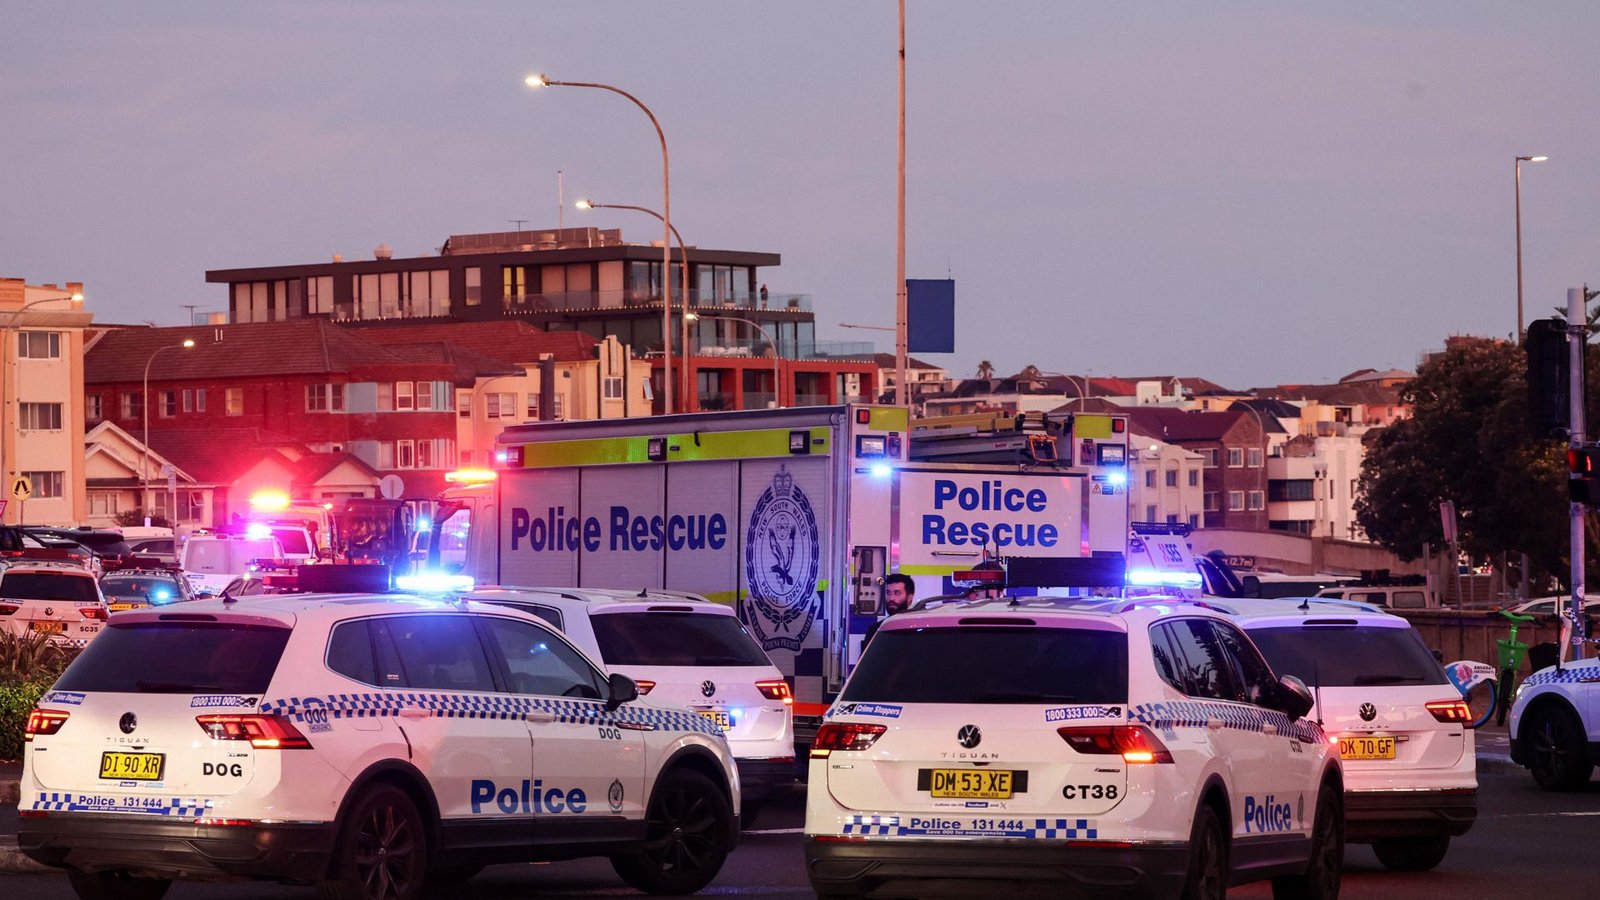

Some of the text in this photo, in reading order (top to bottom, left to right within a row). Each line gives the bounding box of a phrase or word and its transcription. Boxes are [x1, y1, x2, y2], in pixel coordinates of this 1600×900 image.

[934, 480, 1047, 512] Police
[770, 501, 789, 515] SOUTH
[511, 506, 727, 552] Police Rescue
[922, 515, 1058, 548] Rescue
[762, 581, 779, 604] POLICE
[208, 697, 221, 706] 333
[223, 696, 236, 706] 000
[305, 708, 327, 724] 000
[857, 704, 900, 716] Crime Stoppers
[1046, 707, 1098, 720] 1800 333 000
[599, 727, 622, 740] DOG
[1359, 740, 1374, 754] 70
[1378, 740, 1392, 754] GF
[124, 756, 139, 773] 90
[142, 757, 159, 774] XR
[203, 763, 243, 777] DOG
[934, 772, 1009, 792] DM 53 XE
[471, 780, 587, 814] Police
[1062, 785, 1118, 799] CT38
[78, 795, 163, 808] Police 131 444
[1244, 795, 1292, 832] Police
[910, 818, 1024, 830] Police 131 444
